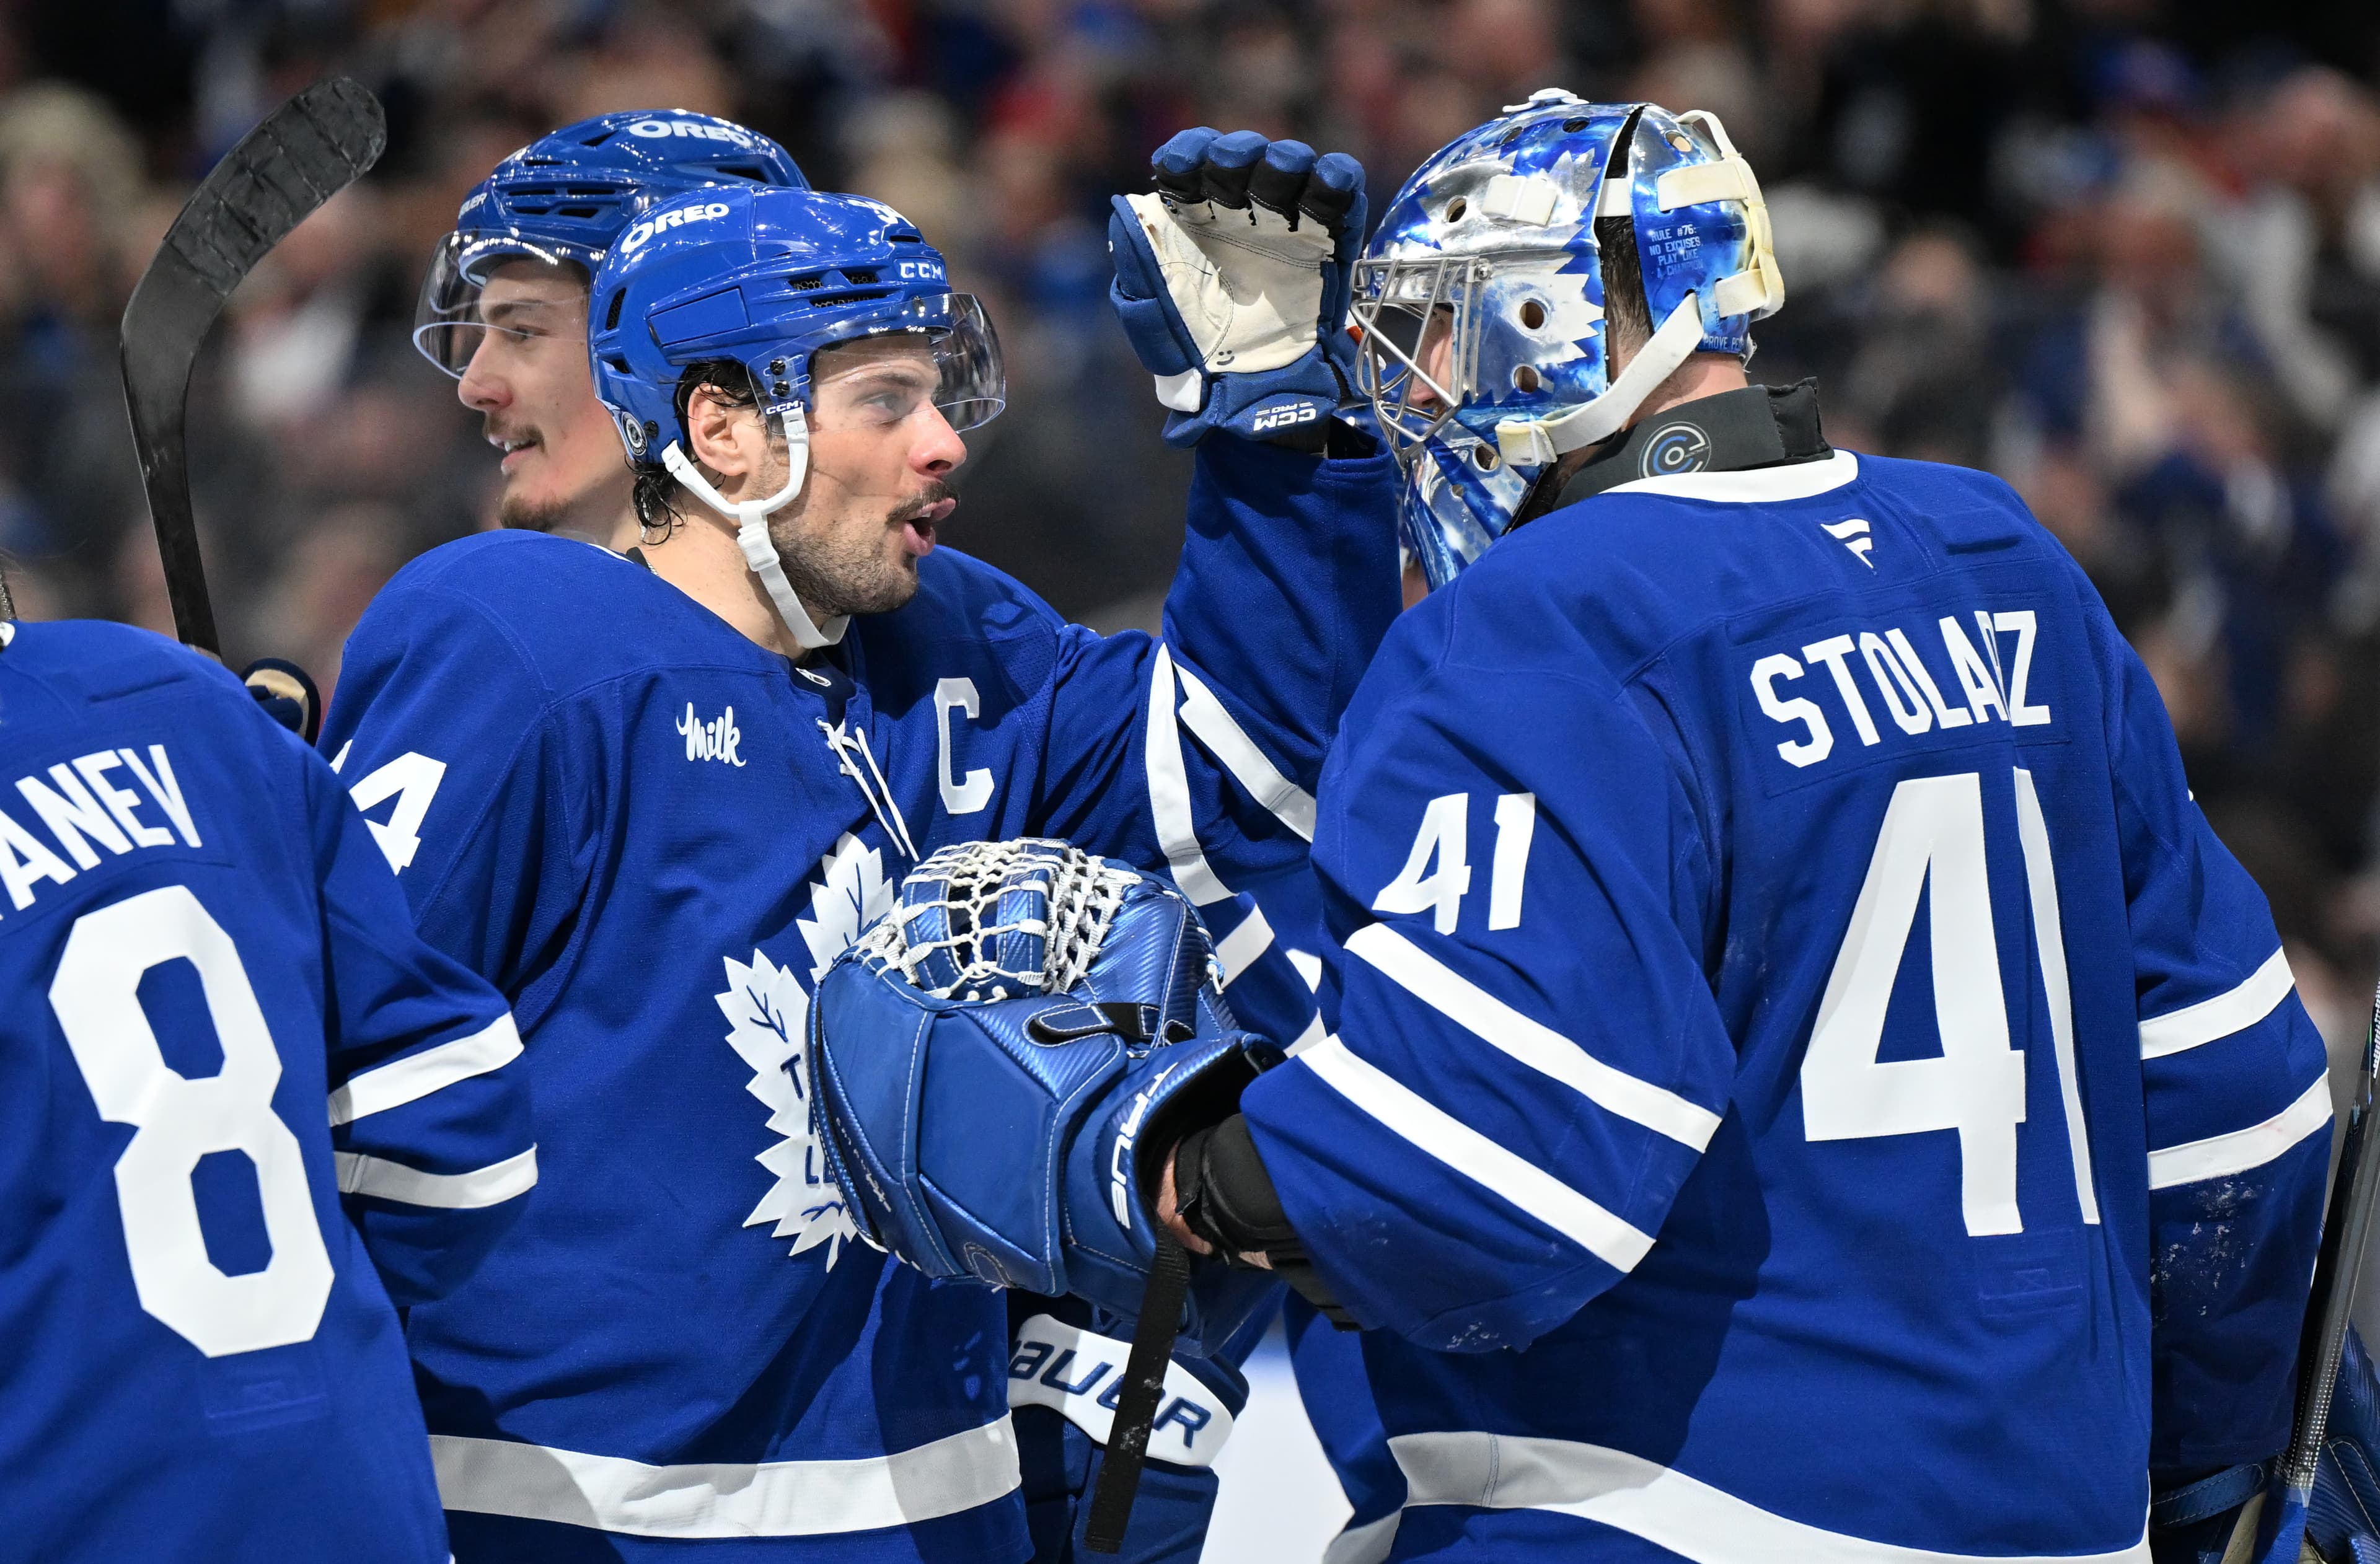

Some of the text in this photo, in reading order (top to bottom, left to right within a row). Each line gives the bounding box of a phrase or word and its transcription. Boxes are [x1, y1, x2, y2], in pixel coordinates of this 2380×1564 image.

[628, 120, 753, 147] OREO
[620, 203, 729, 253] OREO
[1649, 229, 1672, 242] RULE
[1649, 245, 1662, 256] NO
[1658, 248, 1699, 266] PLAY LIKE
[900, 262, 943, 279] CCM
[766, 400, 799, 415] CCM
[1253, 408, 1317, 431] CCM
[1271, 403, 1298, 413] PRO
[676, 701, 746, 767] Milk
[934, 677, 995, 814] C
[0, 744, 203, 921] ANEV
[329, 739, 447, 877] 4
[1372, 792, 1535, 936] 41
[1800, 767, 2100, 1237] 41
[49, 884, 335, 1358] 8
[1111, 1061, 1178, 1229] TRUE
[1008, 1340, 1211, 1449] AUR
